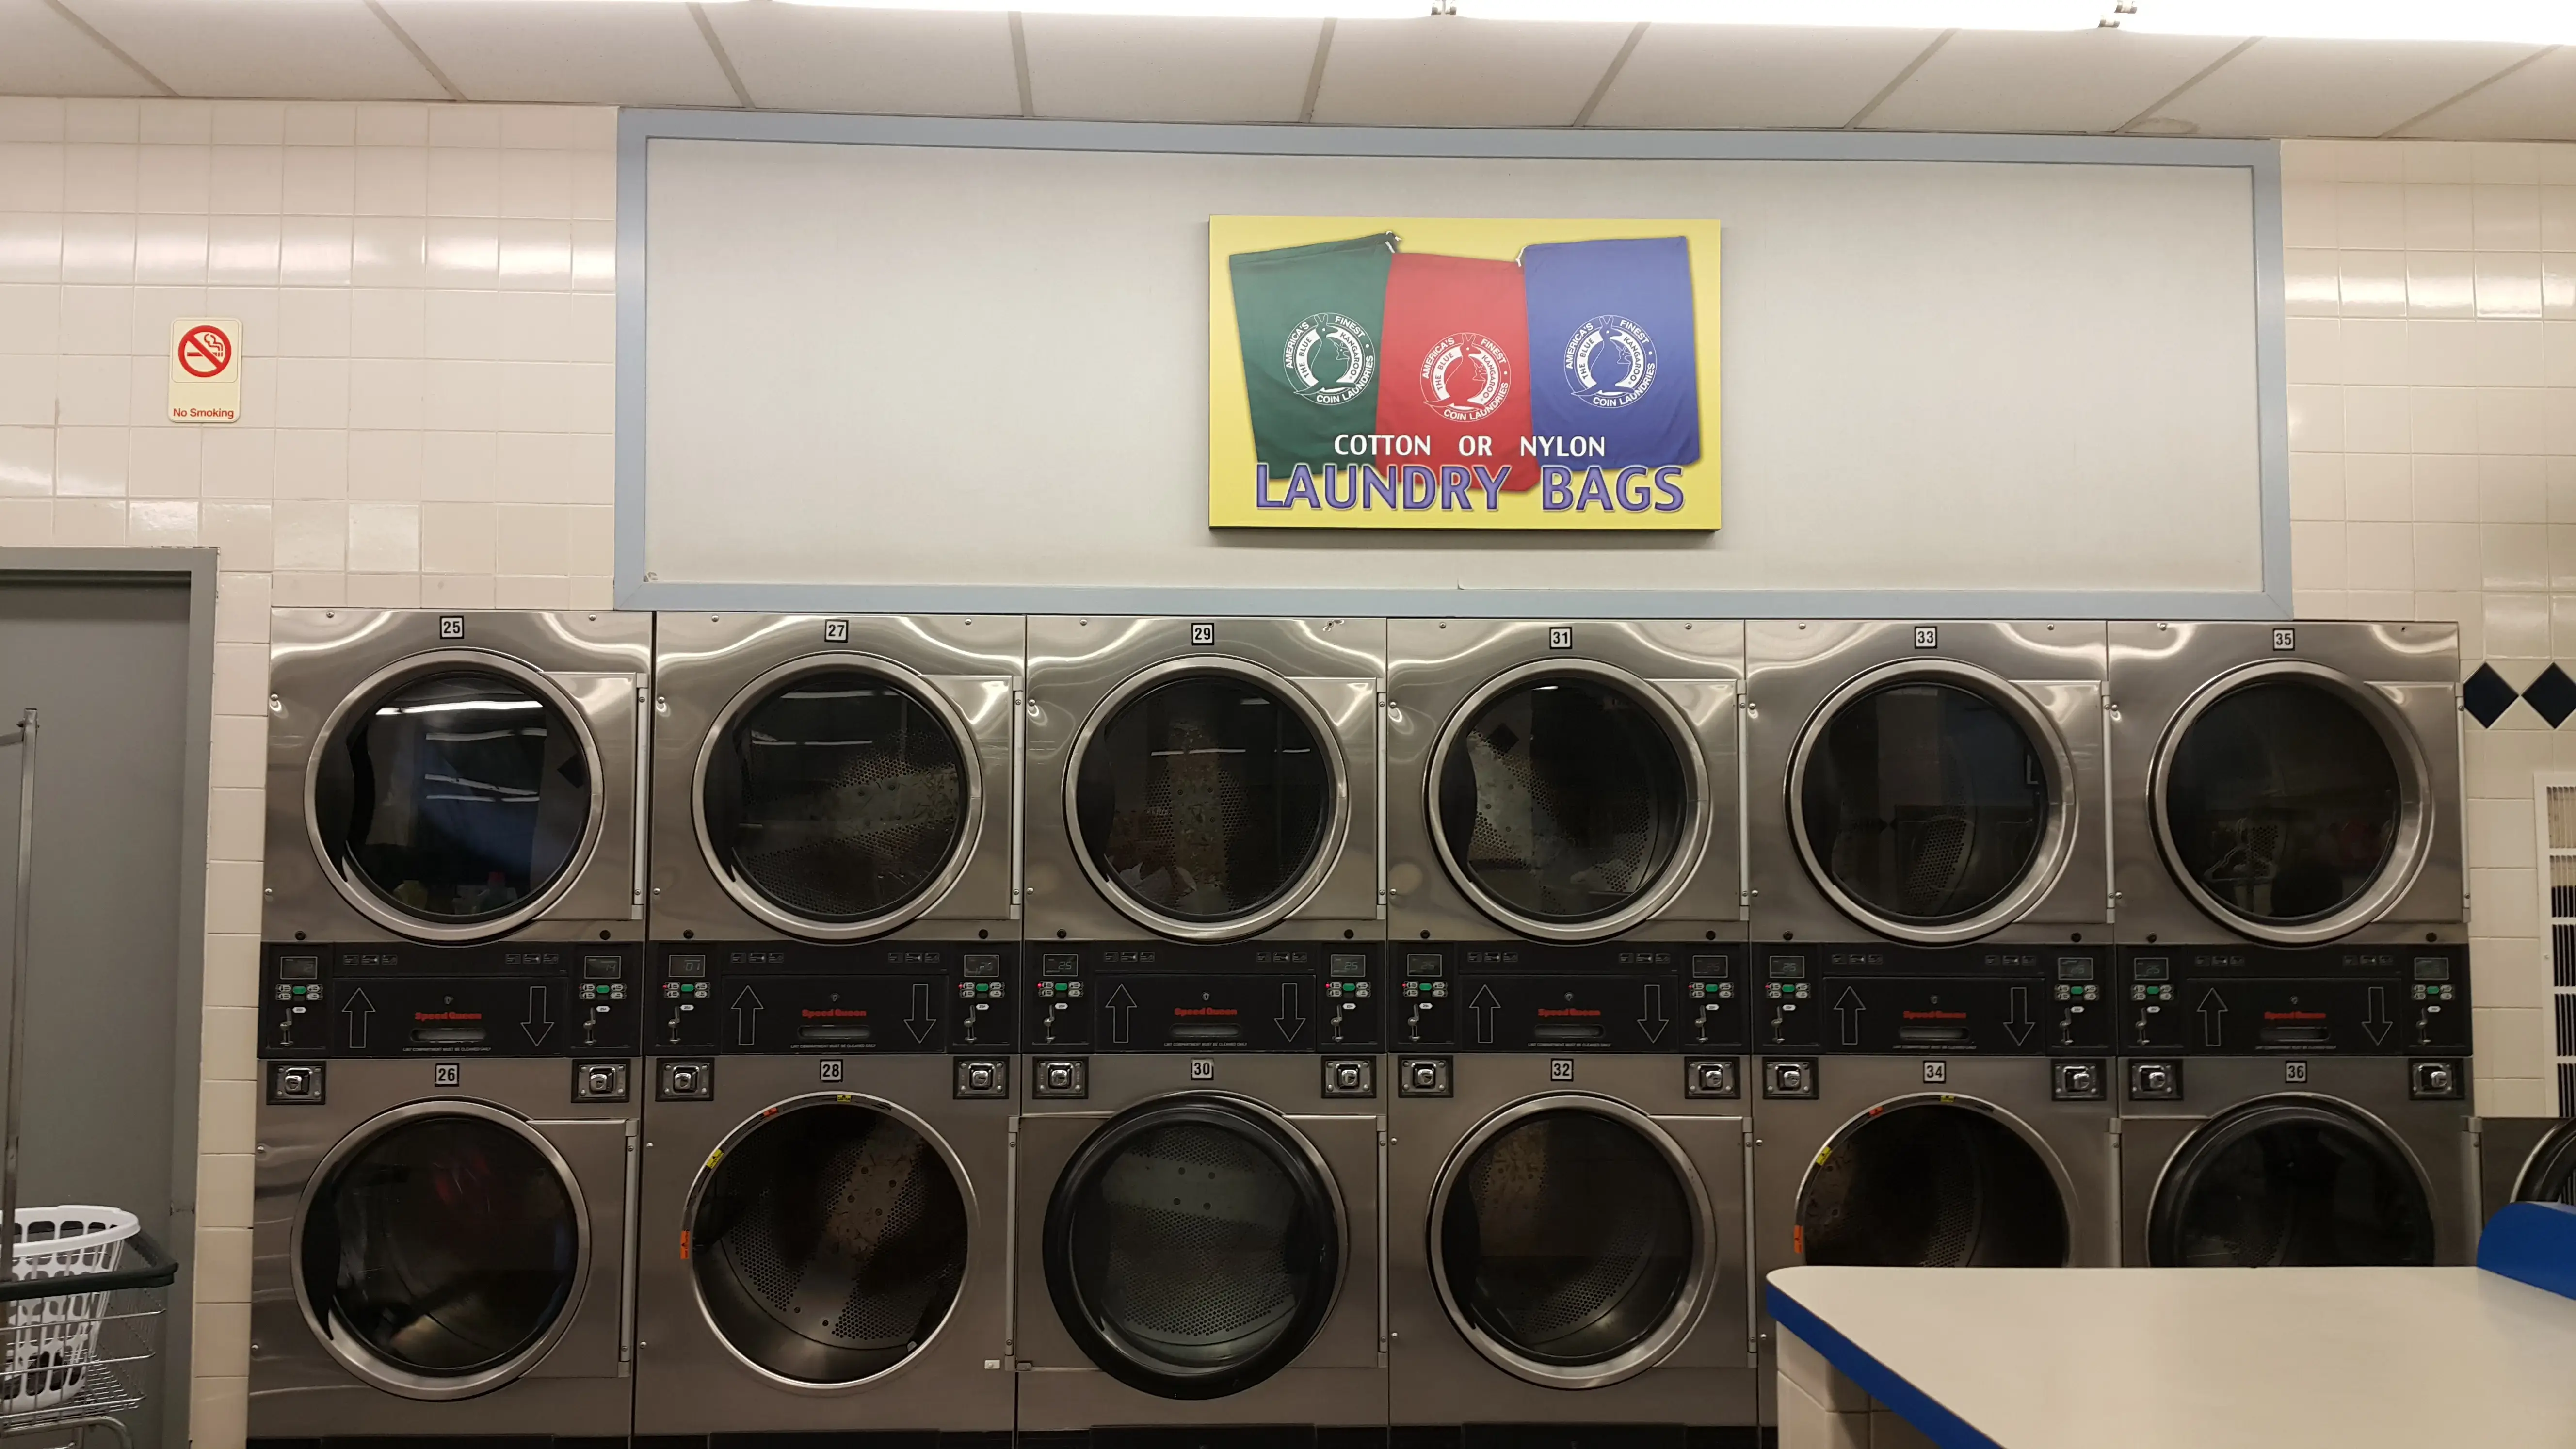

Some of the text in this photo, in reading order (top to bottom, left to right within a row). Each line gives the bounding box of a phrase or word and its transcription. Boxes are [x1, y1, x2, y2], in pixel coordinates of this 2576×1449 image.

[1285, 316, 1365, 369] AMERICA'S FINEST
[1566, 319, 1649, 369] AMERICA'S FINEST
[1299, 332, 1360, 378] THE BLUE KANGAROO
[1422, 338, 1506, 379] AMERICA'S FINEST
[1579, 336, 1641, 381] THE BLUE KANGAROO
[1316, 355, 1373, 403] COIN LAUNDRIES
[1437, 352, 1454, 370] BLUE
[1482, 354, 1496, 399] KANGAROO
[1593, 363, 1655, 406] COIN LAUNDRIES
[1444, 382, 1508, 420] COIN LAUNDRIES
[173, 408, 234, 419] No Smoking
[1334, 434, 1605, 457] COTTON OR NYLON
[1256, 462, 1685, 513] LAUNDRY BAGS
[443, 621, 460, 634] 25
[828, 624, 845, 637] 27
[1194, 628, 1211, 640] 29
[1553, 631, 1568, 644] 31
[1917, 631, 1933, 644] 33
[2276, 633, 2291, 645] 35
[1058, 961, 1072, 970] 25
[1344, 961, 1358, 970] 25
[438, 1068, 455, 1081] 26
[822, 1064, 839, 1077] 28
[1194, 1062, 1210, 1075] 30
[1553, 1063, 1570, 1076] 32
[1926, 1065, 1942, 1078] 34
[2288, 1065, 2304, 1078] 36
